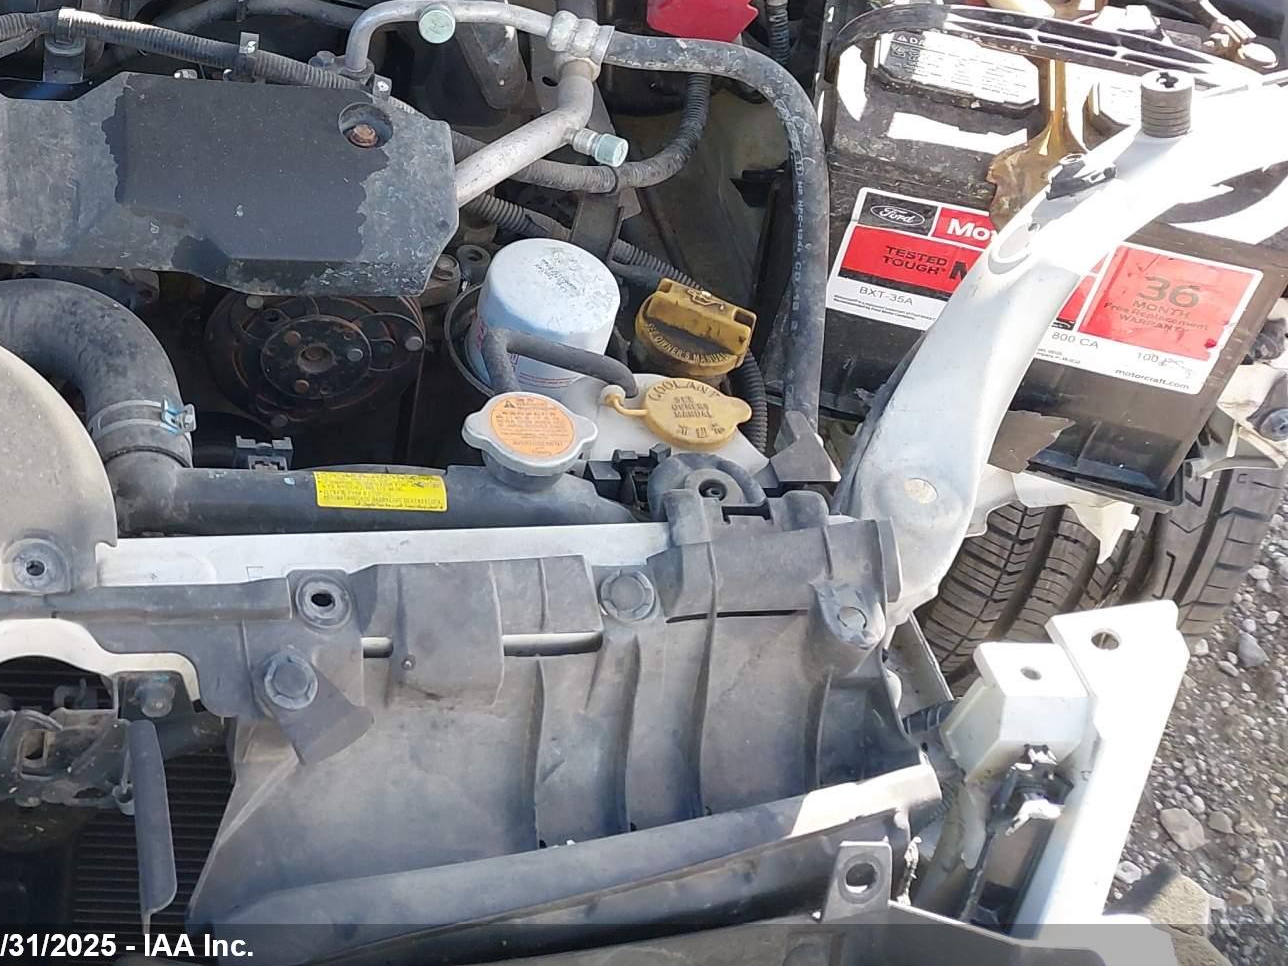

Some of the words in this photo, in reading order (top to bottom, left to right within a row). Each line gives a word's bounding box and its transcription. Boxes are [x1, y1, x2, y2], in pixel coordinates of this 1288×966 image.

[879, 206, 915, 225] Ford
[885, 245, 948, 266] TESTED
[859, 286, 913, 305] BXT-35A
[1137, 275, 1202, 308] 36
[1130, 307, 1209, 331] Replacement
[1132, 300, 1191, 318] MONTH
[1120, 313, 1190, 335] WARRANTY
[1051, 331, 1075, 344] 800
[1079, 337, 1099, 349] CA
[692, 351, 729, 364] MANUAL
[1115, 368, 1190, 390] motorcraft.com
[648, 379, 721, 402] COOLANT
